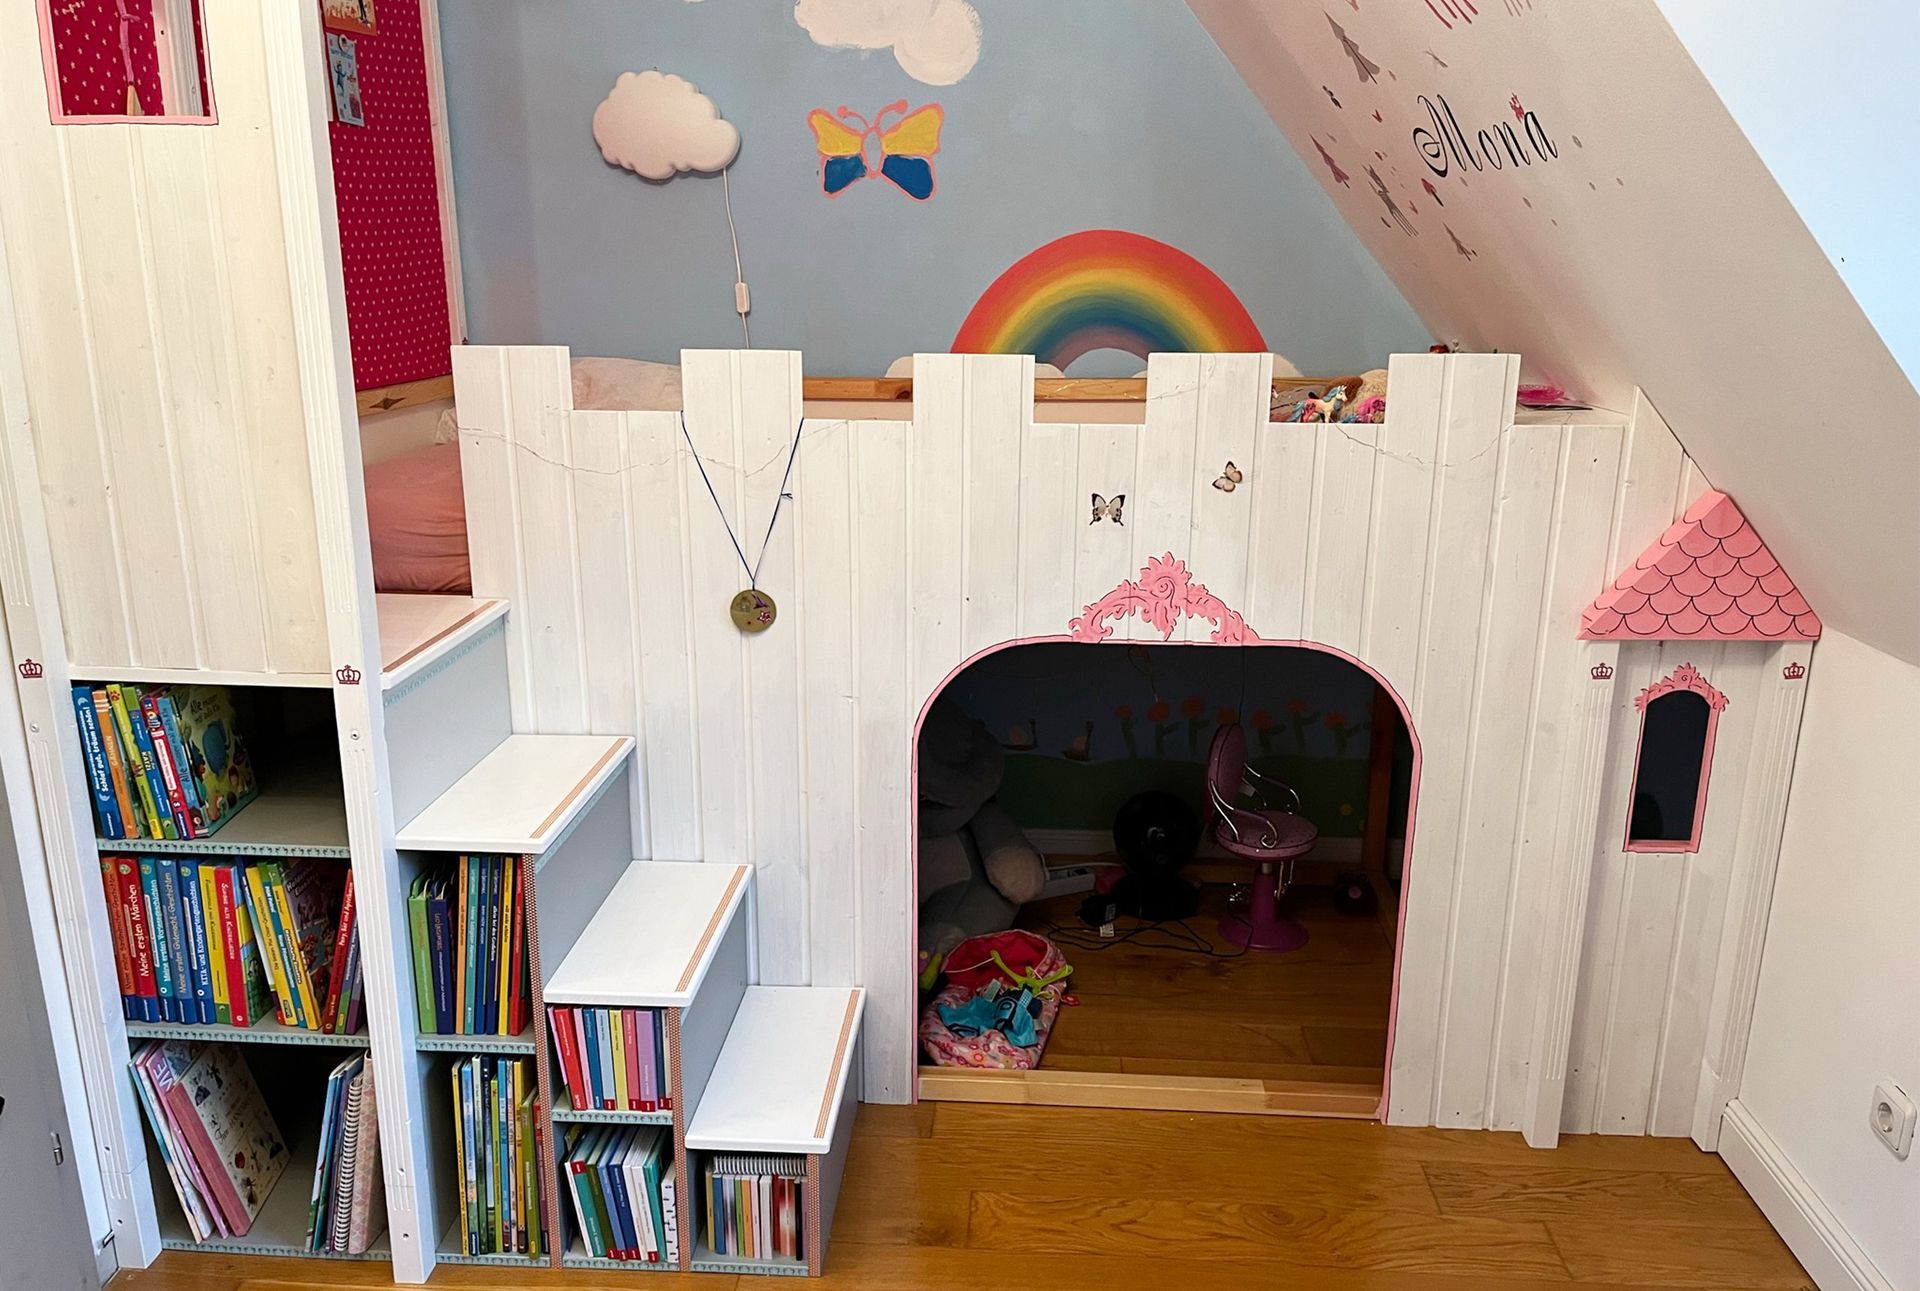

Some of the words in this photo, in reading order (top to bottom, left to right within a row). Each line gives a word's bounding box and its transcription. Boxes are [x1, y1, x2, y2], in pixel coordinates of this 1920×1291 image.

[1413, 94, 1558, 177] Mona
[82, 705, 95, 730] schön!
[88, 730, 100, 752] träum
[96, 768, 109, 792] Schlaf
[178, 766, 190, 783] Alle
[126, 883, 141, 921] Märchen
[133, 923, 145, 949] ersten
[158, 940, 167, 961] ersten
[175, 951, 183, 971] ersten
[198, 953, 206, 964] und
[137, 951, 149, 977] Meine
[161, 962, 171, 981] Meine
[178, 973, 187, 993] Meine
